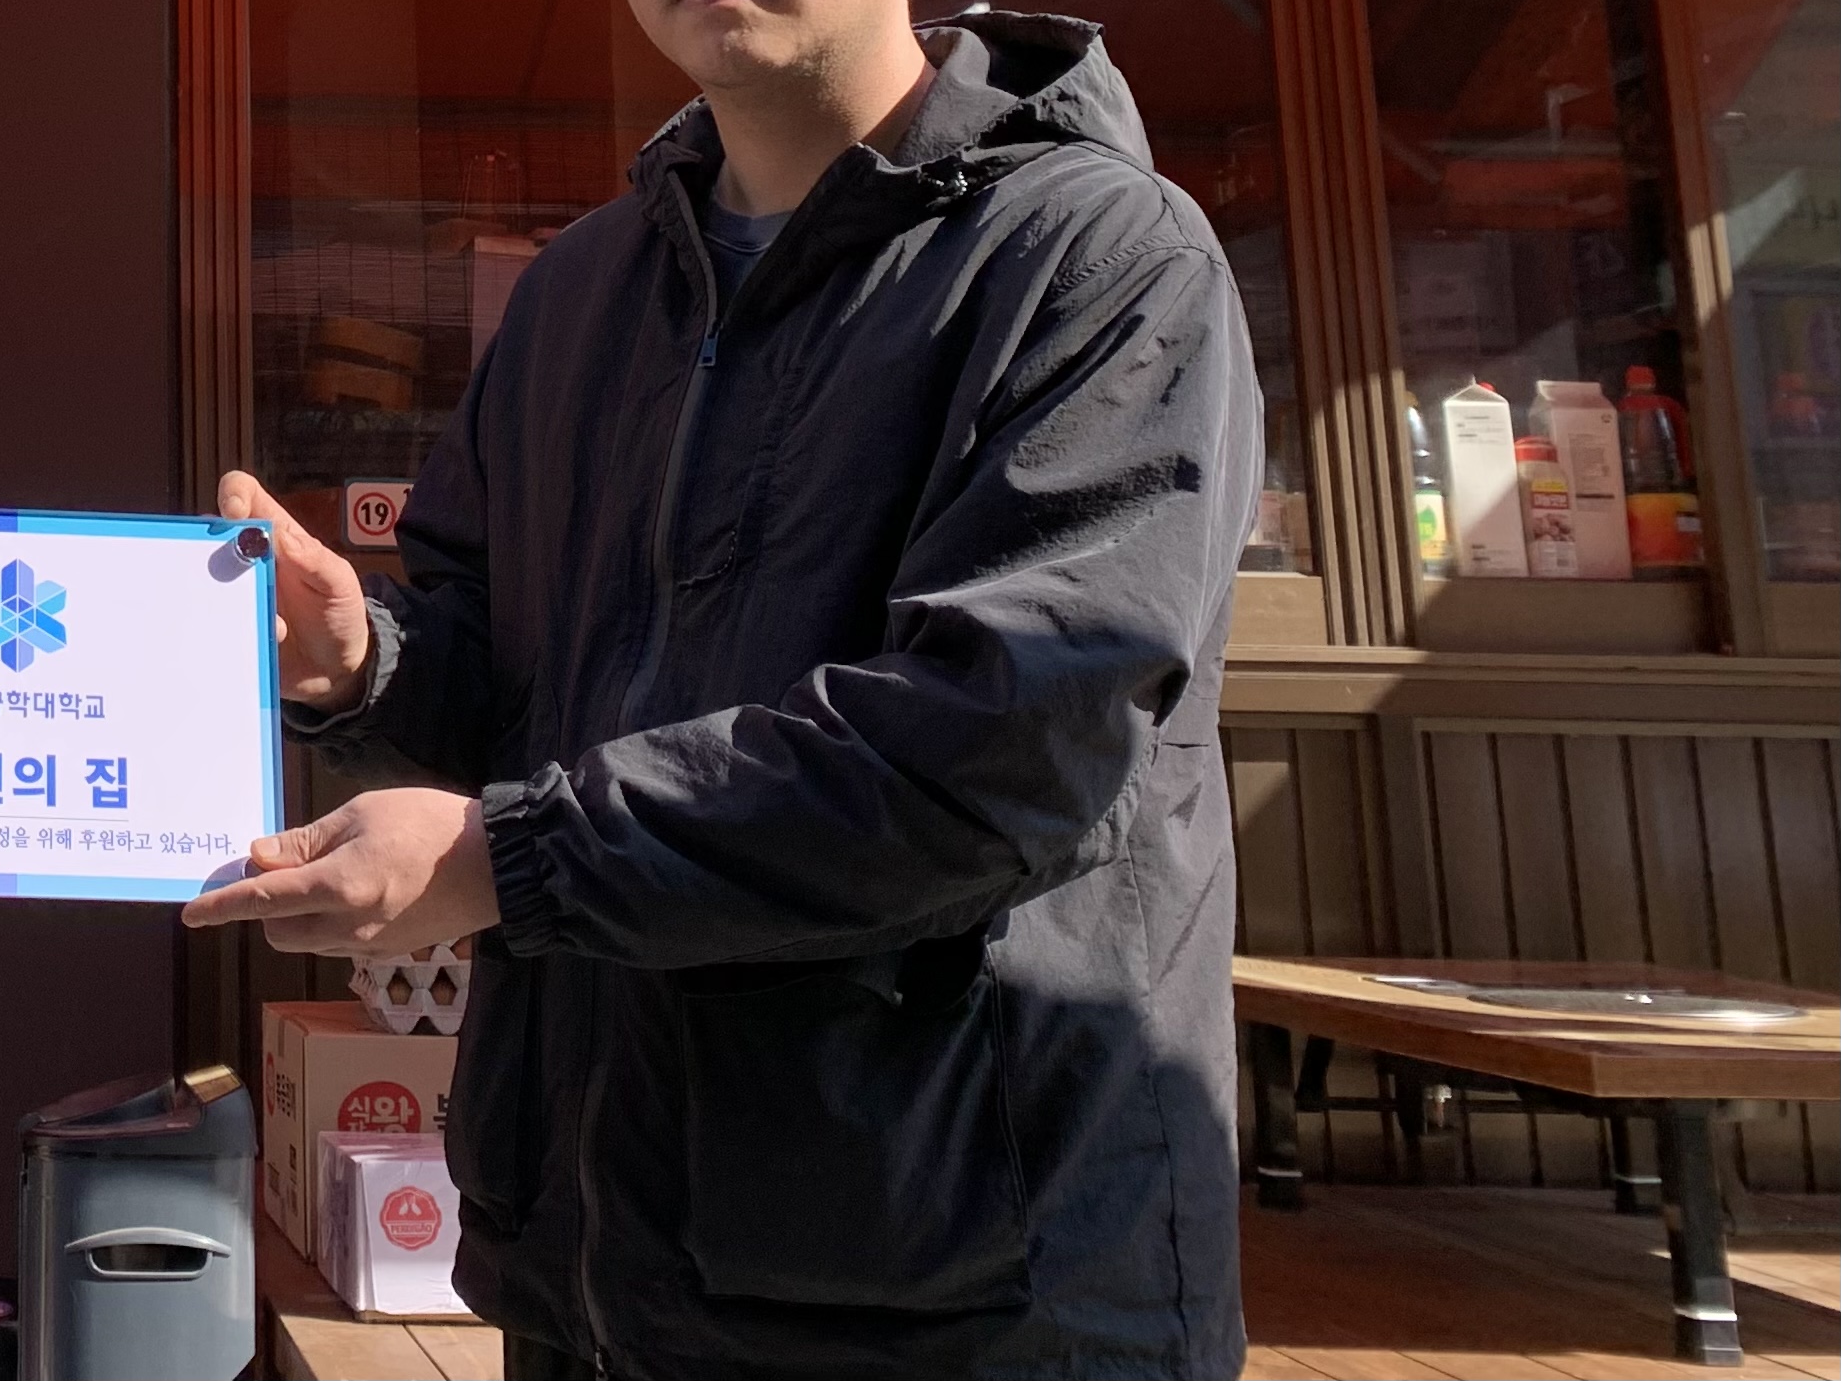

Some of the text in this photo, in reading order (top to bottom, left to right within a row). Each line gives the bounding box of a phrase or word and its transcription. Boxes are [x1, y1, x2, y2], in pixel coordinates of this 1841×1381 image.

[361, 502, 389, 526] 19
[84, 757, 128, 809] 집
[36, 827, 72, 851] 위해
[78, 829, 153, 852] 후원하고
[159, 831, 237, 856] 있습니다.
